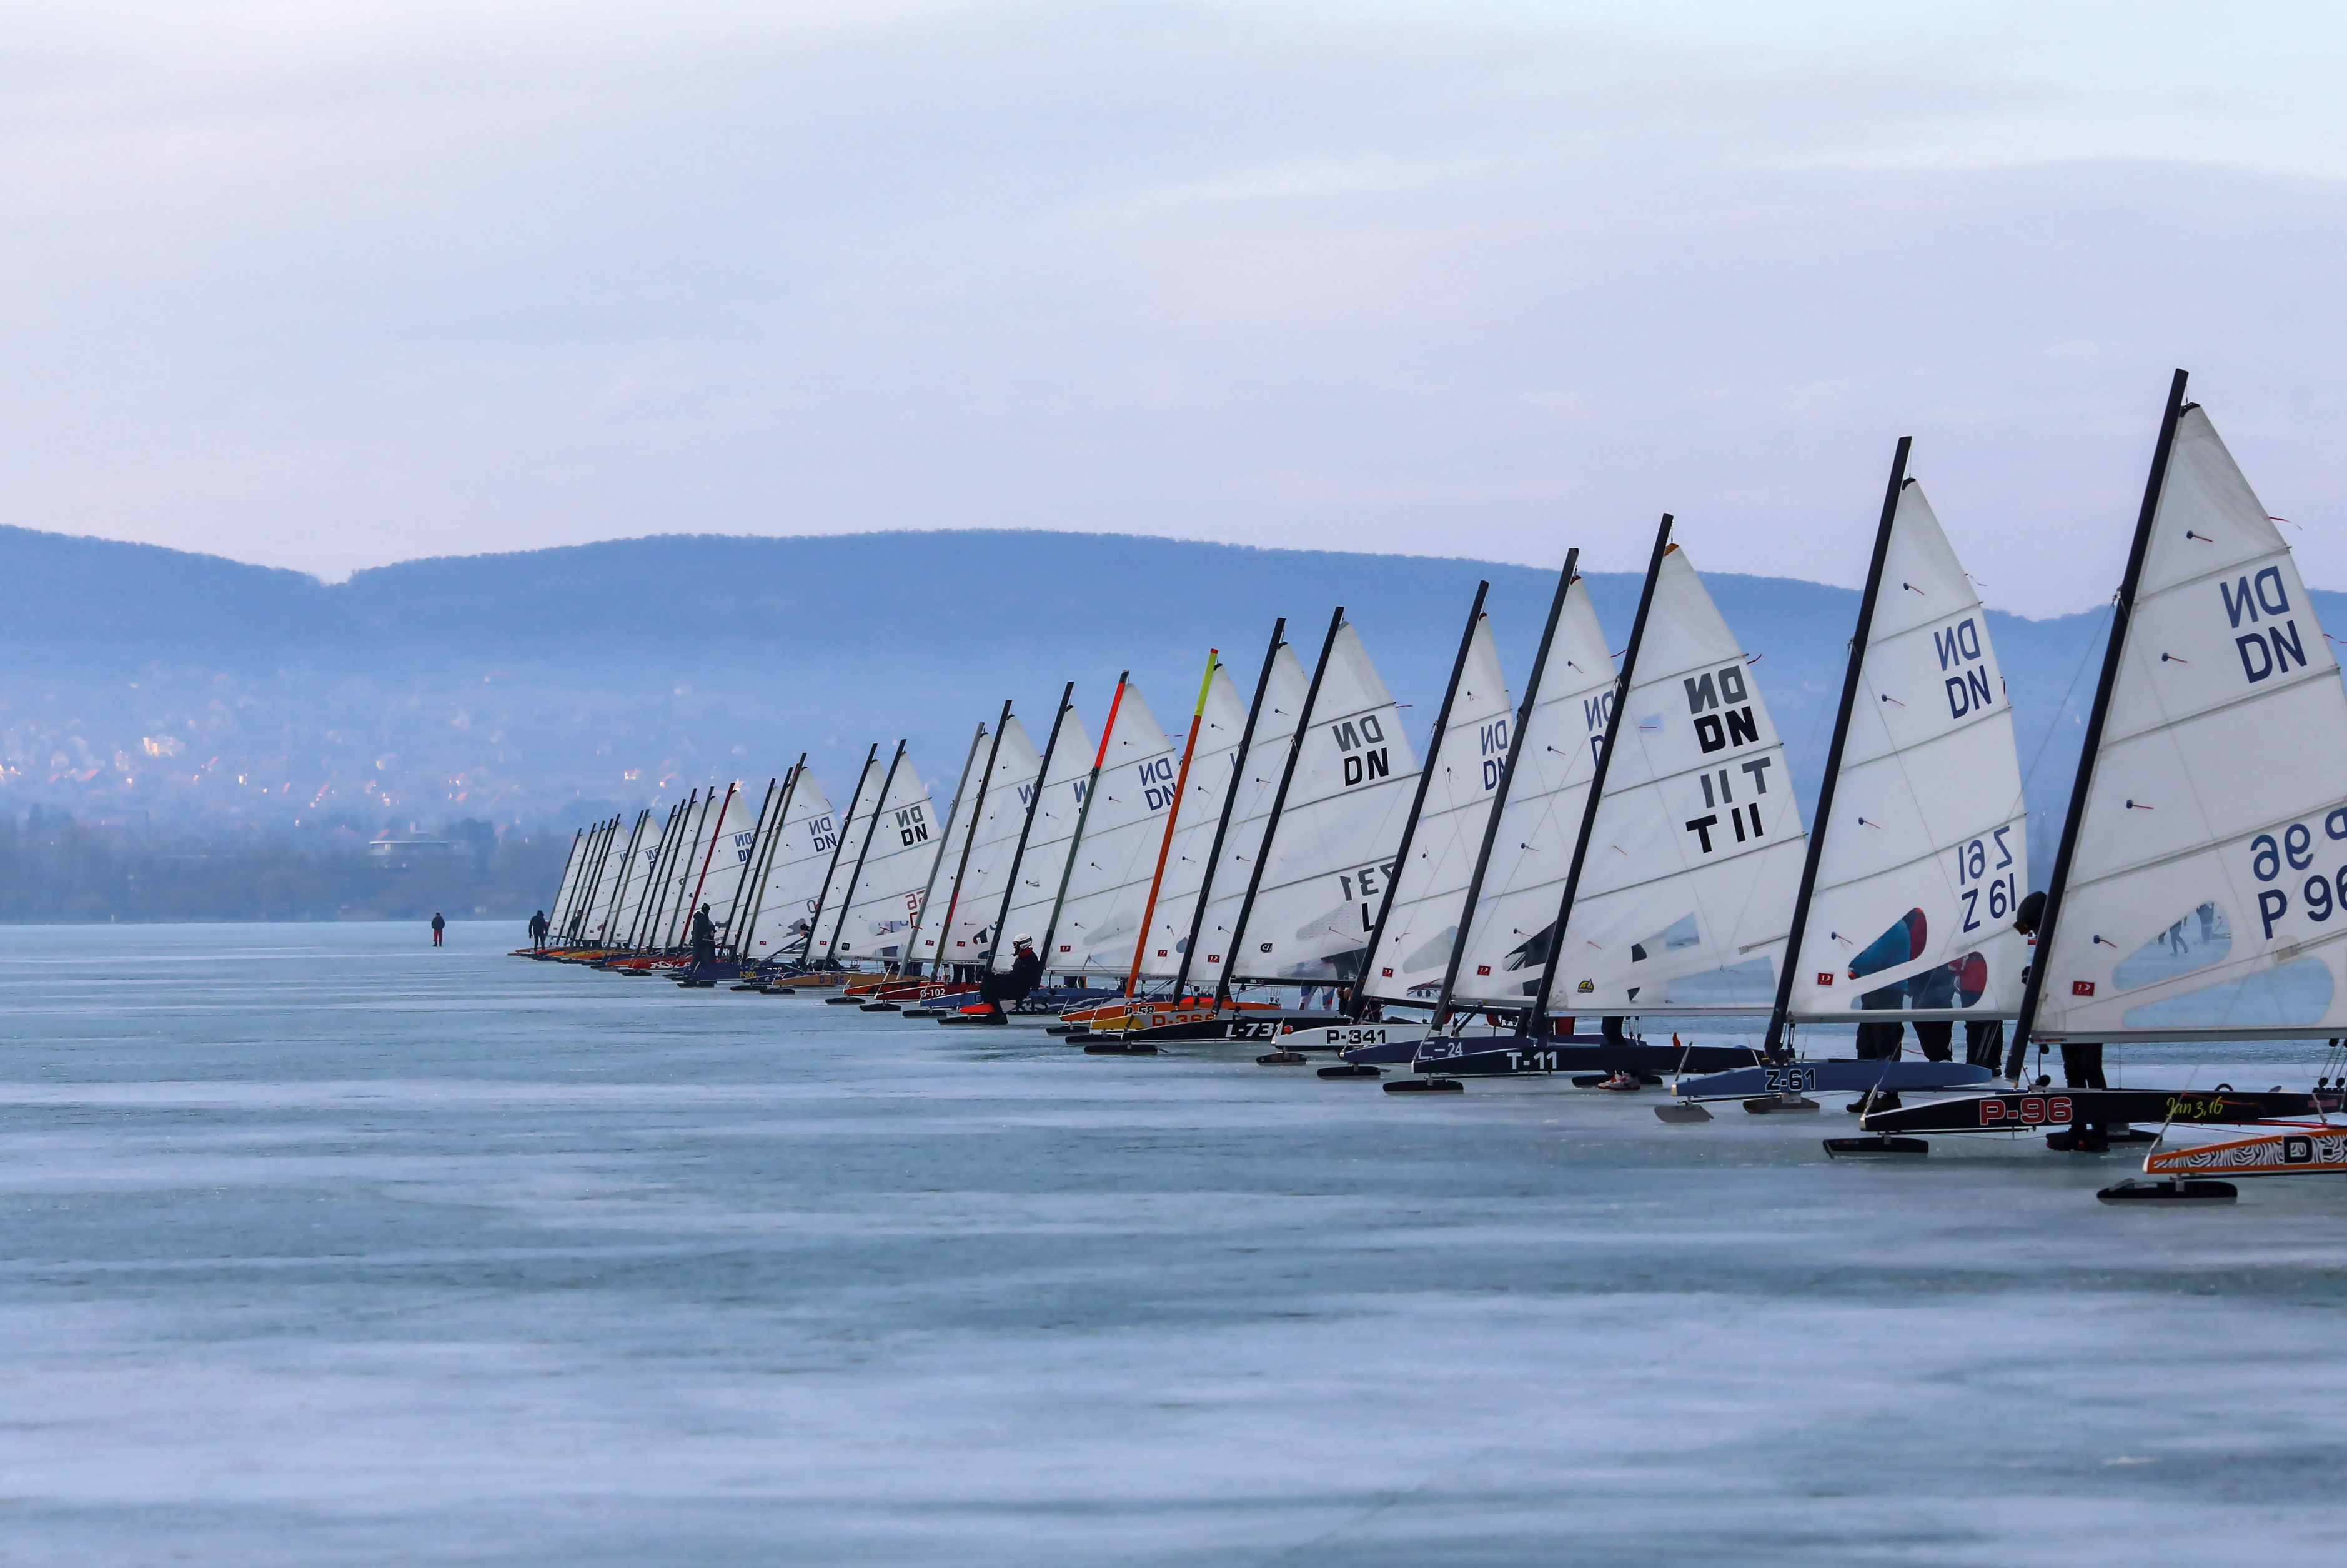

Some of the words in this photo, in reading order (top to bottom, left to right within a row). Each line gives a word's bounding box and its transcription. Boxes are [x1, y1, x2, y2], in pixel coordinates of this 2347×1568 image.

[2235, 620, 2307, 683] DN
[1945, 665, 1992, 719] DN
[1693, 705, 1759, 753] DN
[1344, 747, 1389, 787] DN
[1144, 782, 1177, 810] DN
[813, 833, 838, 852] DN
[900, 823, 928, 846] DN
[1685, 814, 1718, 854] T
[1962, 888, 1980, 933] Z
[1989, 873, 2016, 919] 61
[2258, 889, 2288, 940] P
[818, 976, 845, 985] D-156
[1327, 1029, 1386, 1045] P-341
[1506, 1051, 1558, 1071] T-11
[1765, 1068, 1816, 1092] Z-61
[1978, 1096, 2073, 1126] P-96
